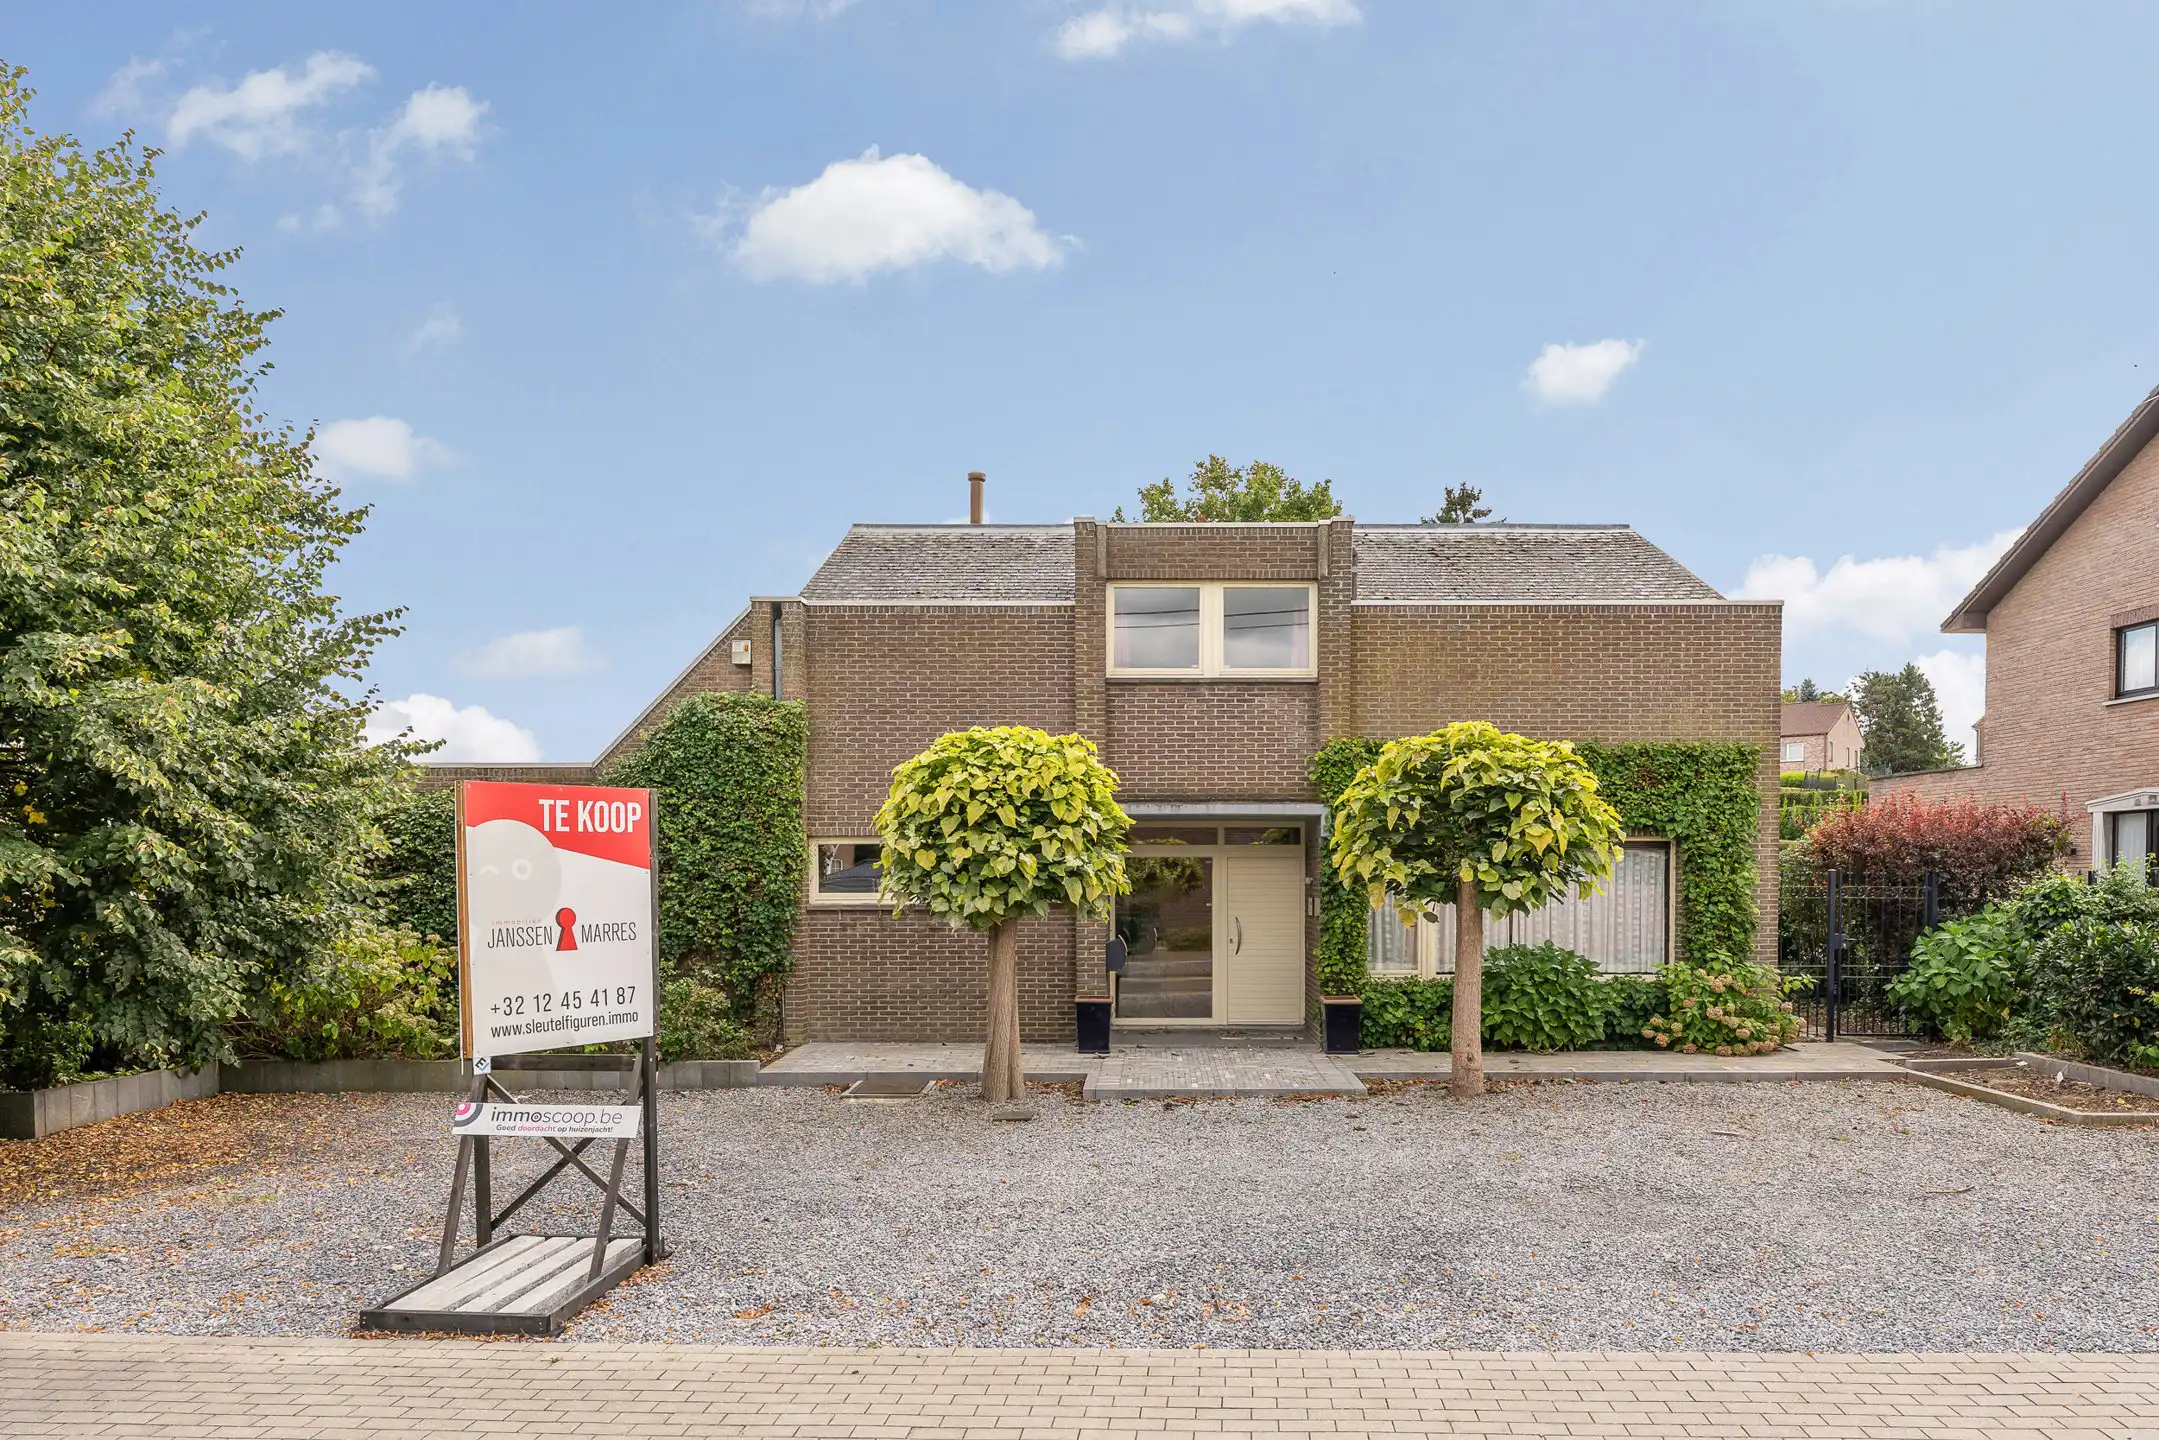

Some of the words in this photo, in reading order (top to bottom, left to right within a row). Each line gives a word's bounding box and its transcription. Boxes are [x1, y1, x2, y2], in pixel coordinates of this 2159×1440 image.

[538, 798, 570, 832] TE
[577, 800, 642, 833] KOOP
[487, 926, 553, 949] JANSSEN
[581, 922, 637, 943] MARRES
[490, 996, 525, 1016] +32
[533, 993, 552, 1012] 12
[560, 990, 582, 1010] 45
[590, 988, 608, 1007] 41
[616, 986, 636, 1004] 87
[490, 1011, 639, 1038] www.sleutelfiguren.immo
[491, 1106, 623, 1126] immoscoop.be
[518, 1124, 556, 1132] doordacht
[568, 1126, 613, 1134] huizenjacht!
